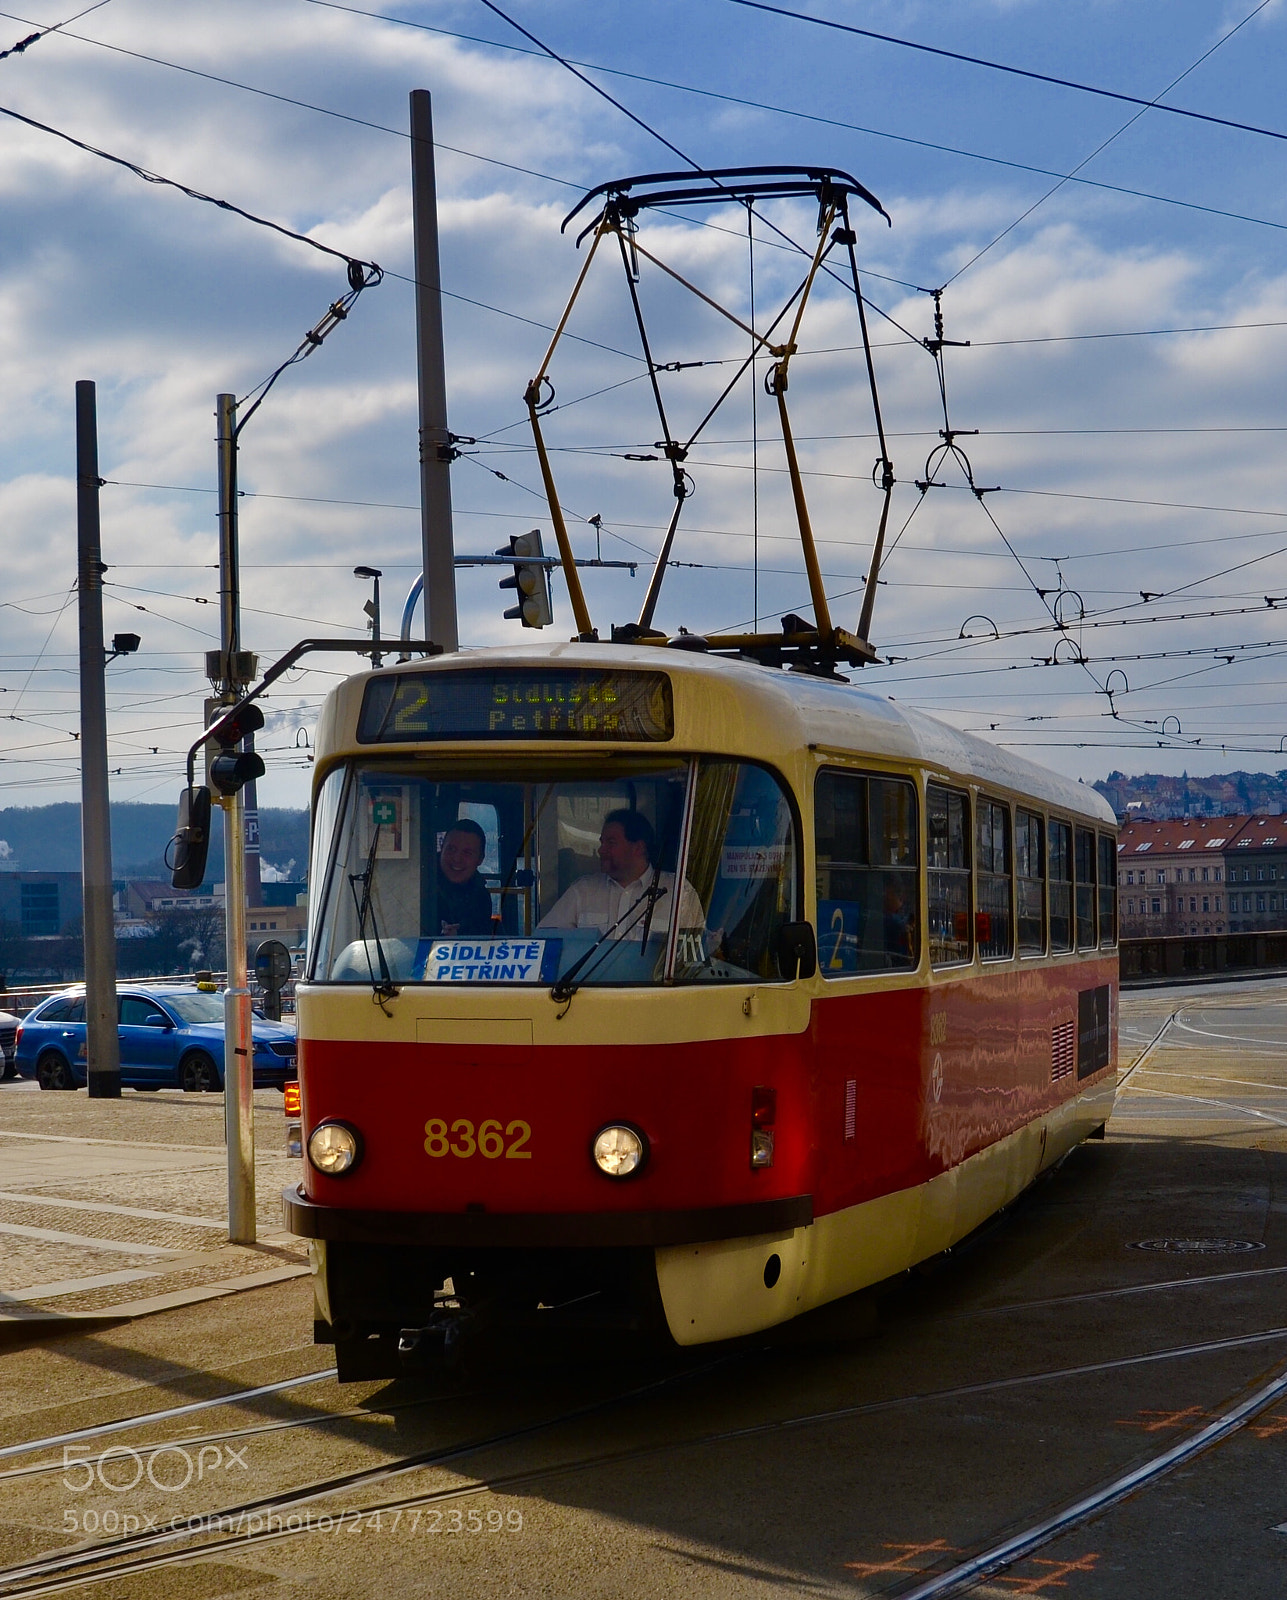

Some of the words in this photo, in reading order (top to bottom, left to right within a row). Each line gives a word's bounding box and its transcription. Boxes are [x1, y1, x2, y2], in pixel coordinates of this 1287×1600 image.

[492, 679, 618, 704] Sídliště
[394, 680, 430, 732] 2
[488, 706, 619, 732] Petřiny
[435, 941, 540, 961] SÍDLIŠTĚ
[829, 907, 843, 969] 2
[436, 961, 532, 980] PETŘINY
[423, 1118, 532, 1159] 8362
